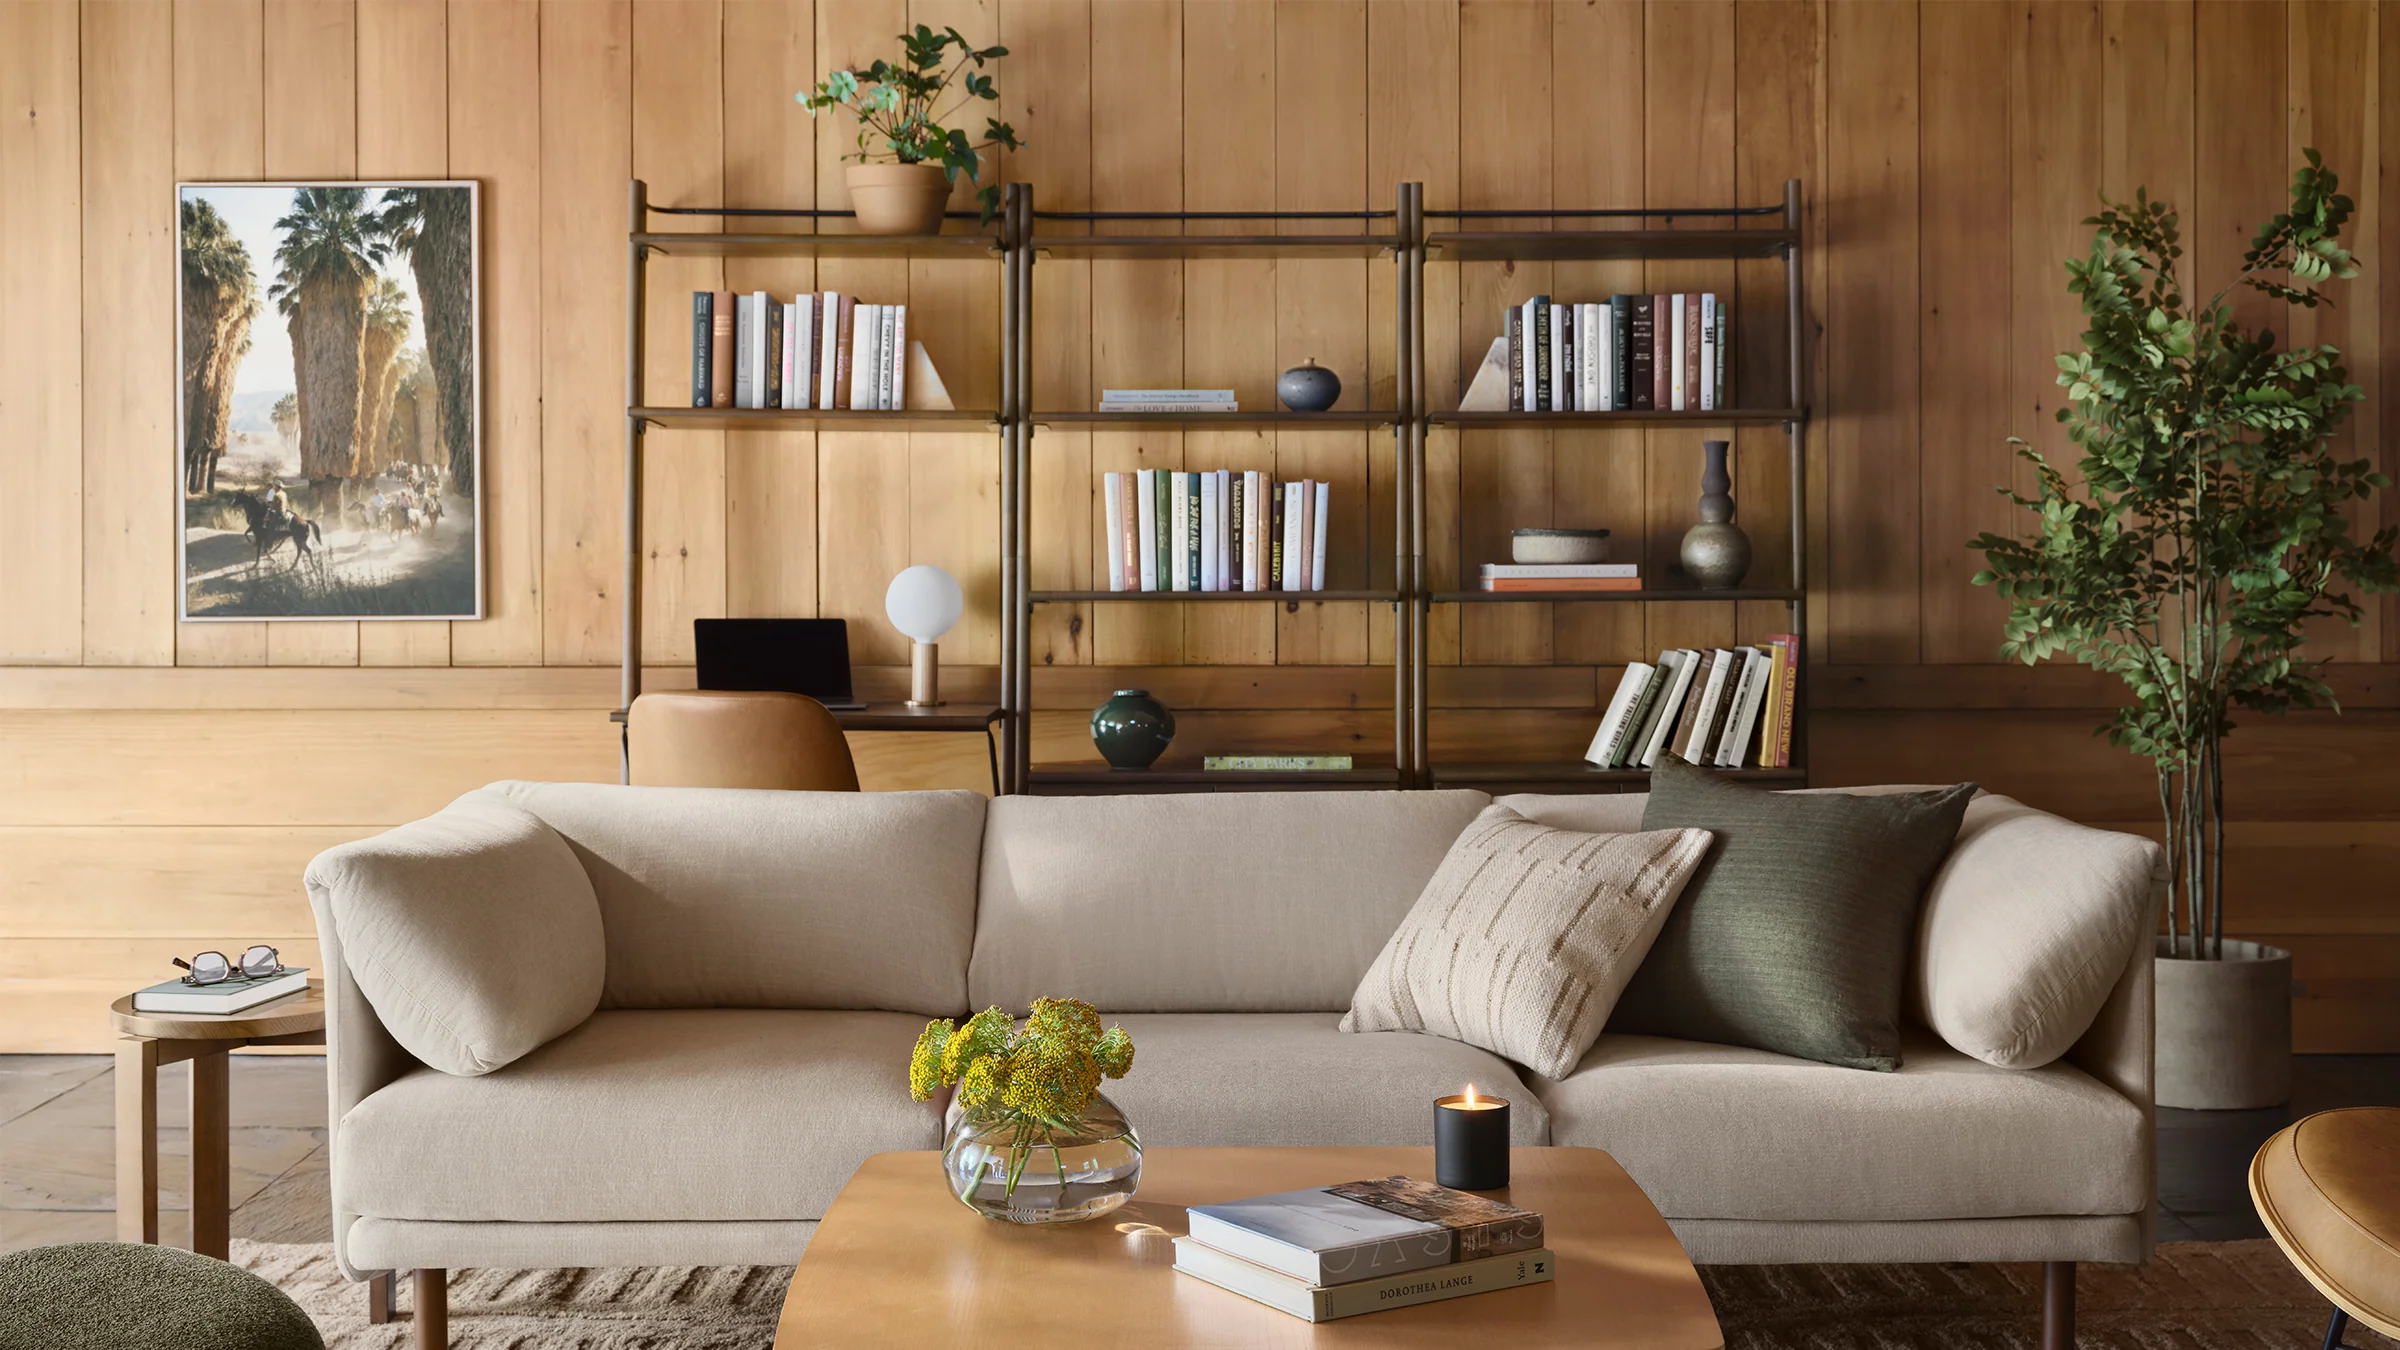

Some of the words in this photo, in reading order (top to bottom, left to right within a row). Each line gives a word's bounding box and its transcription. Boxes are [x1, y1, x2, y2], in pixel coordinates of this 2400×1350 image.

[1143, 404, 1165, 412] LOVE
[1175, 404, 1201, 412] HOME
[1233, 480, 1242, 529] VAGABONDS
[1786, 666, 1795, 688] OLD
[1630, 693, 1639, 704] THE
[1784, 690, 1793, 727] BRAND
[1619, 705, 1633, 729] FALLING
[1609, 730, 1621, 748] GIRLS
[1781, 729, 1789, 753] NEW
[1265, 758, 1306, 769] PARKS
[1517, 1261, 1525, 1280] Yale
[1380, 1282, 1437, 1300] DOROTHEA
[1440, 1275, 1474, 1290] LANGE
